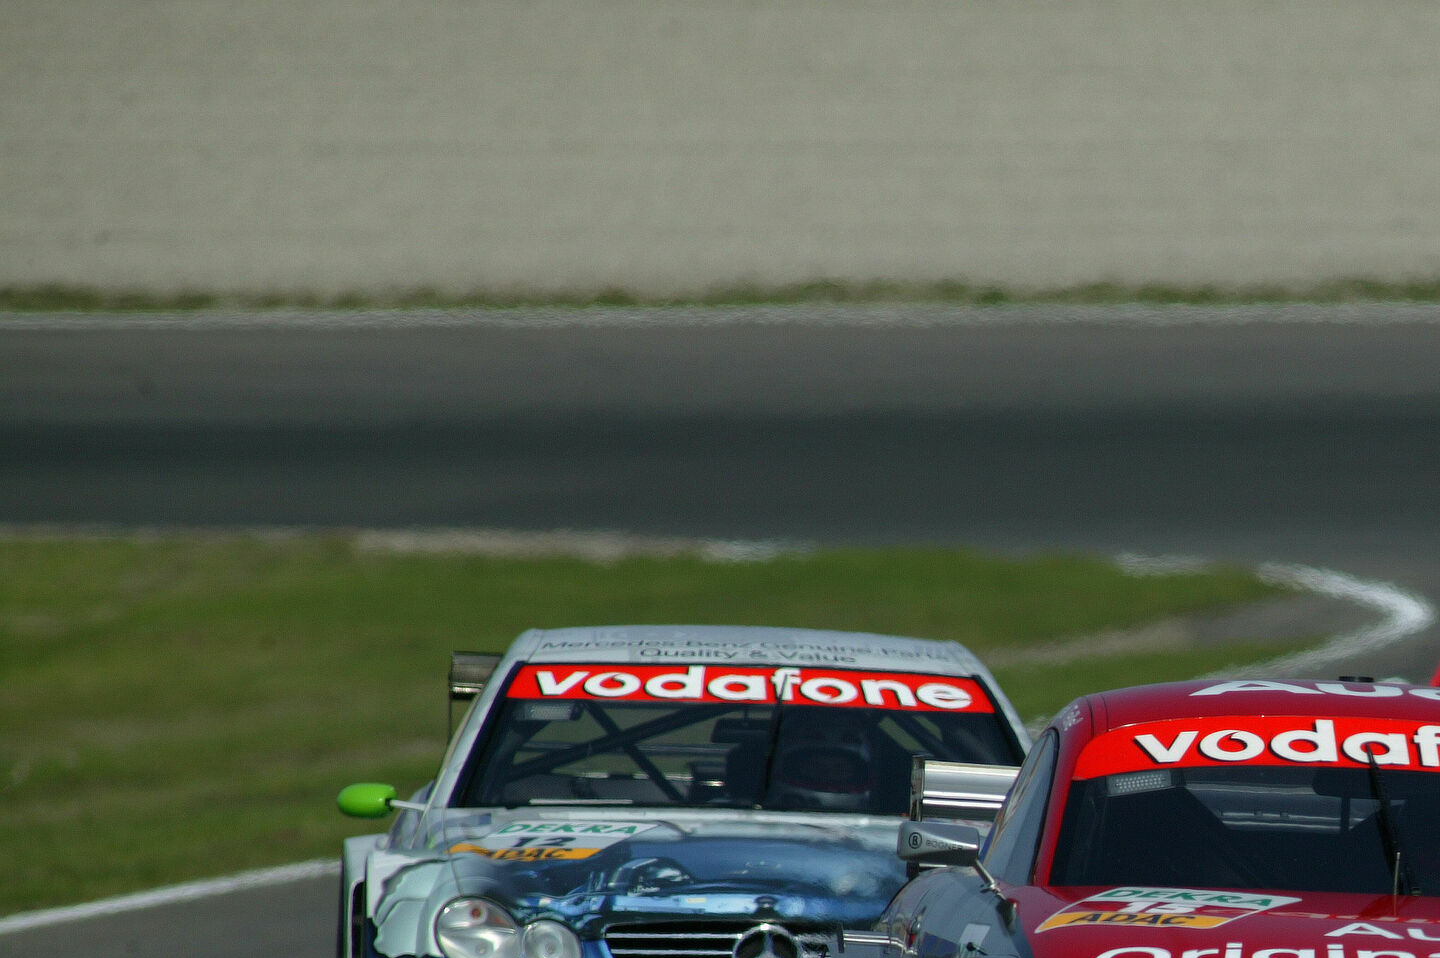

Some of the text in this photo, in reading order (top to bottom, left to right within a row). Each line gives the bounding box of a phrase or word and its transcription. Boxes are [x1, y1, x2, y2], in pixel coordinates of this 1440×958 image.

[640, 649, 738, 660] Quality
[775, 650, 856, 663] Value
[536, 665, 973, 709] vodafone
[497, 823, 638, 835] DEKRA
[1102, 889, 1275, 907] DEKRA
[1117, 901, 1206, 914] 15
[1066, 913, 1196, 926] ADAC
